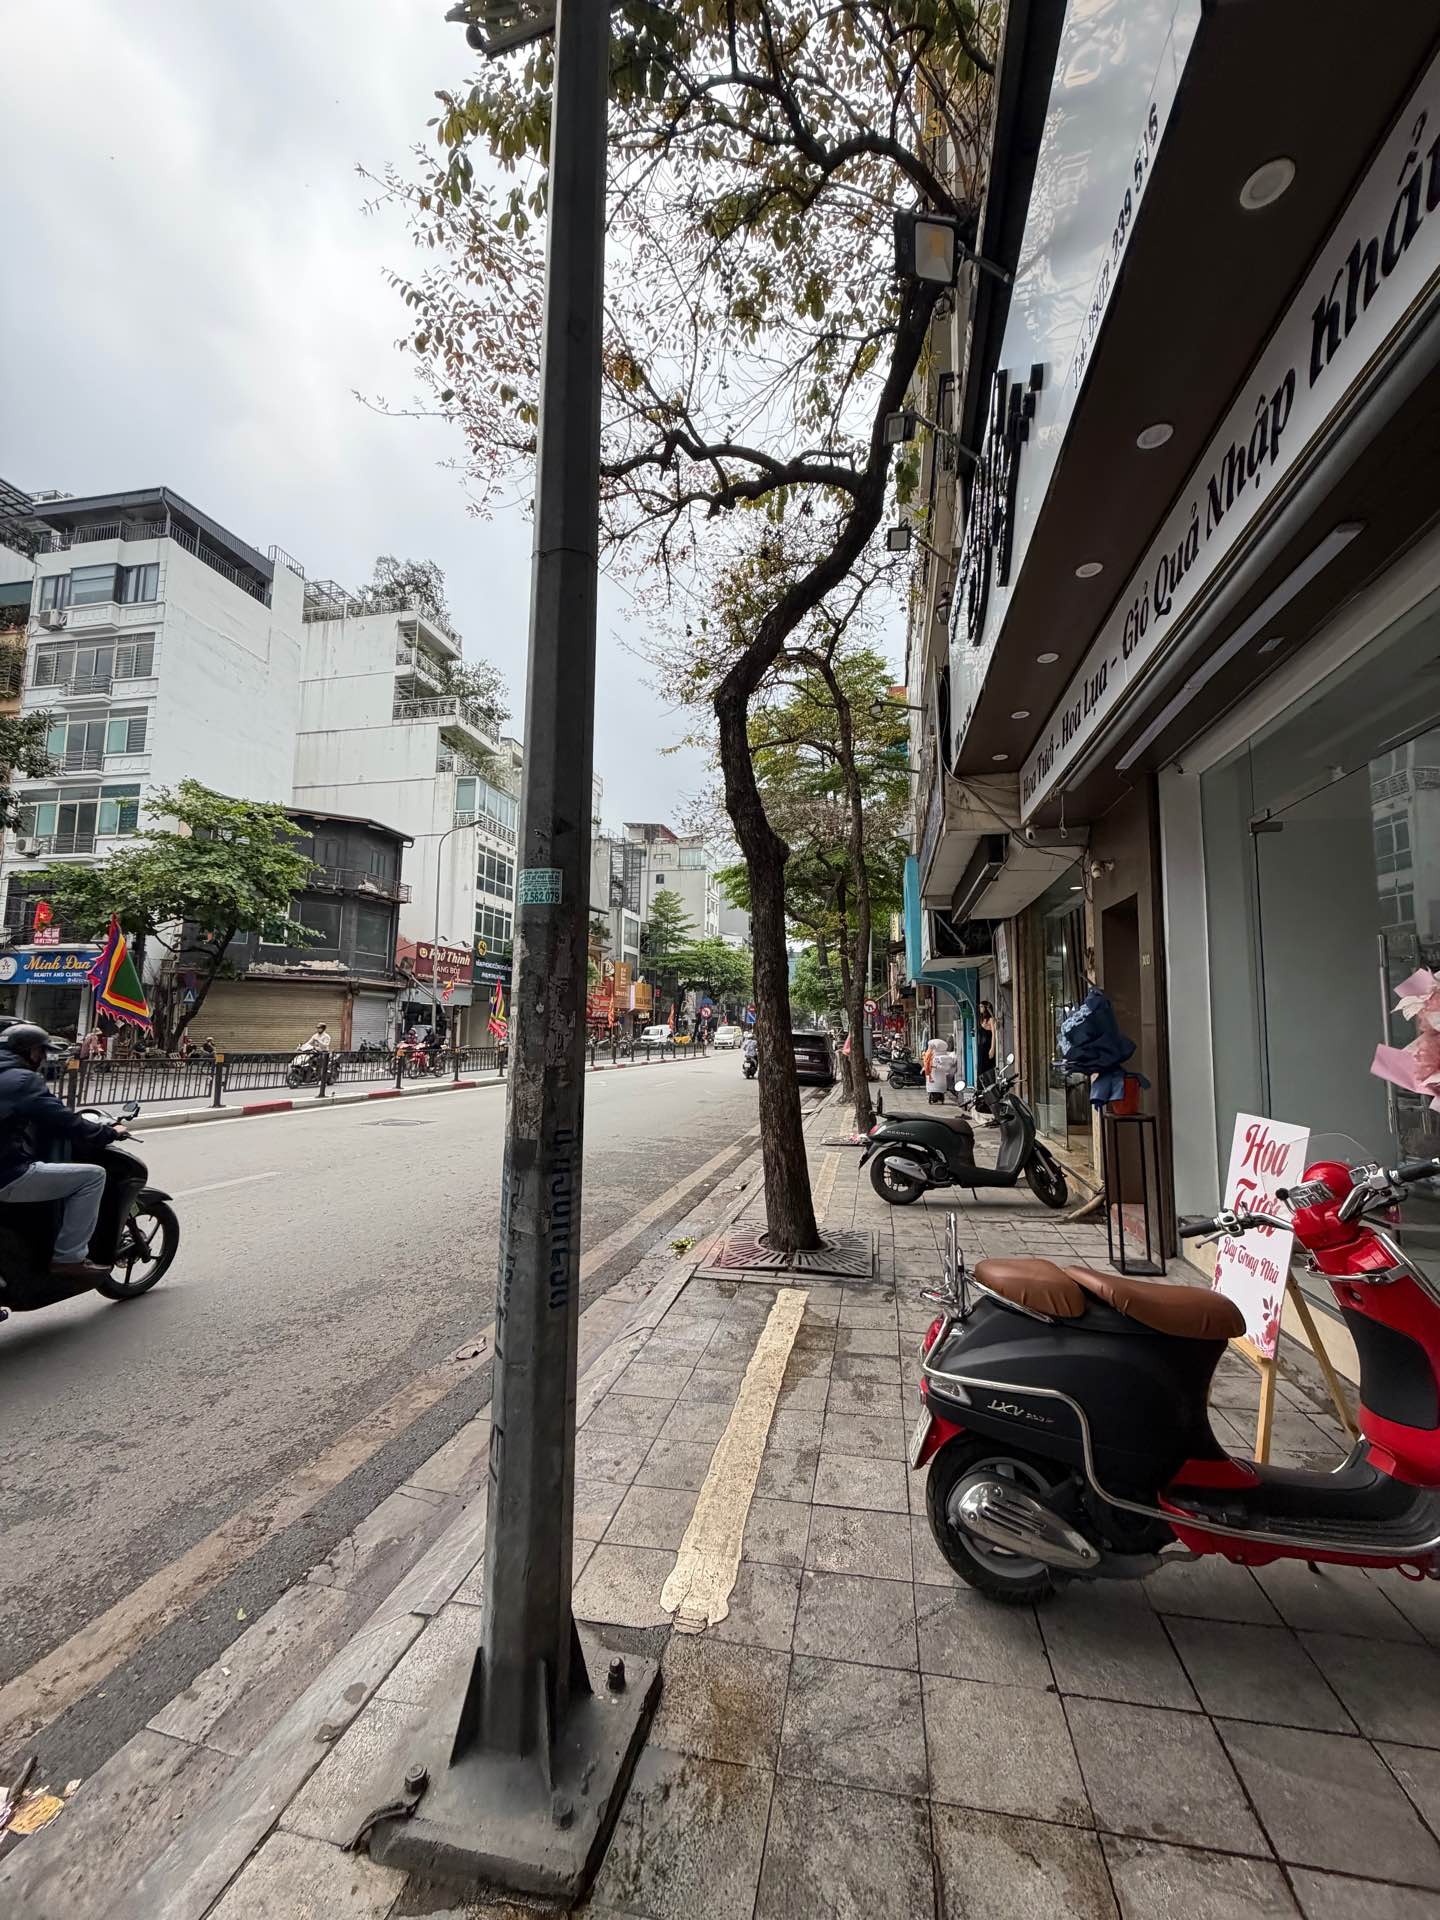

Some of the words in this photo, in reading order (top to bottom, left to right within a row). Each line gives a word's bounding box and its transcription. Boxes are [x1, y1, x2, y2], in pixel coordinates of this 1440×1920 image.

[1111, 187, 1132, 270] 239
[1023, 772, 1037, 806] Hoa
[1061, 699, 1082, 751] Hoa
[1083, 659, 1108, 719] Lụa
[1122, 580, 1150, 660] Giỏ
[1153, 501, 1200, 624] Quả
[1206, 367, 1297, 541] Nhập
[23, 955, 61, 970] Minh
[446, 951, 471, 967] Thịnh
[1240, 1123, 1291, 1178] Hoa
[1222, 1236, 1238, 1264] Bày
[1237, 1245, 1260, 1278] Trong
[1259, 1257, 1280, 1285] Nhà
